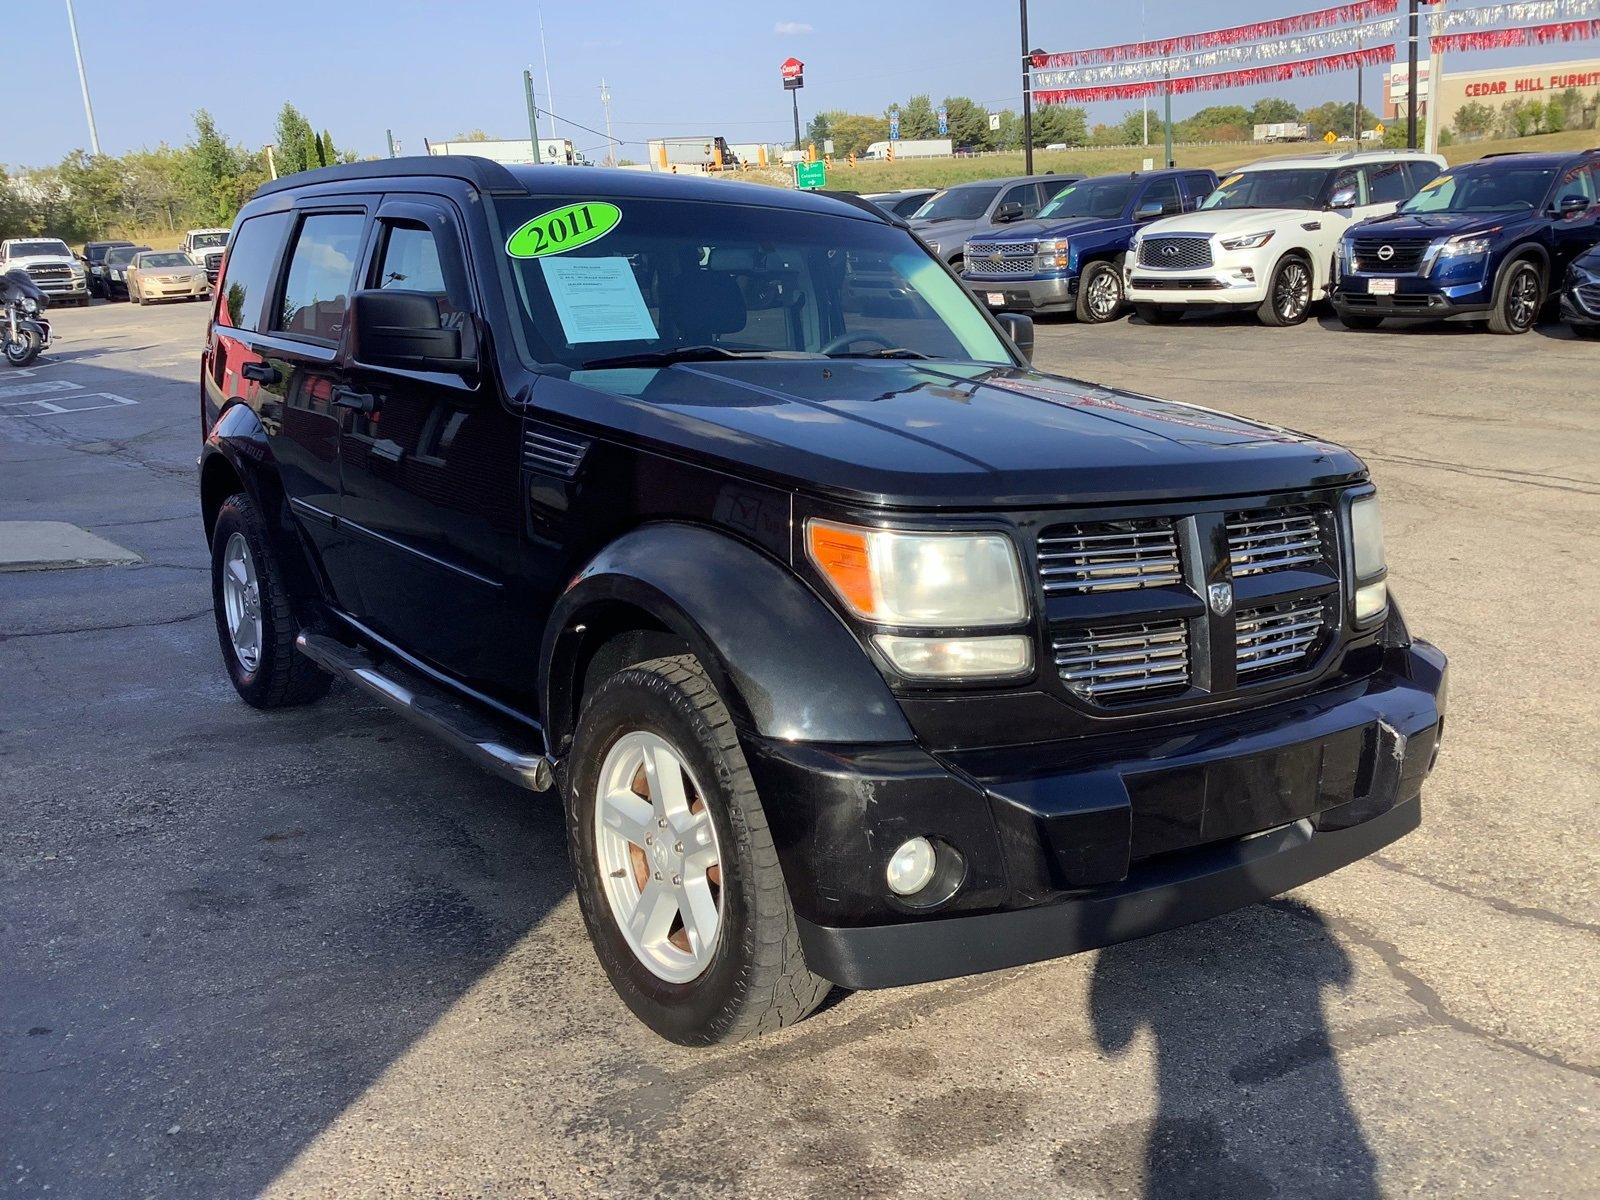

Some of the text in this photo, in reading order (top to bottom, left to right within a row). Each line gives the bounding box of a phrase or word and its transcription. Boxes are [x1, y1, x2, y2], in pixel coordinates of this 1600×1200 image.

[1465, 81, 1507, 97] CEDAR
[1514, 77, 1544, 93] HILL
[527, 205, 597, 254] 2011
